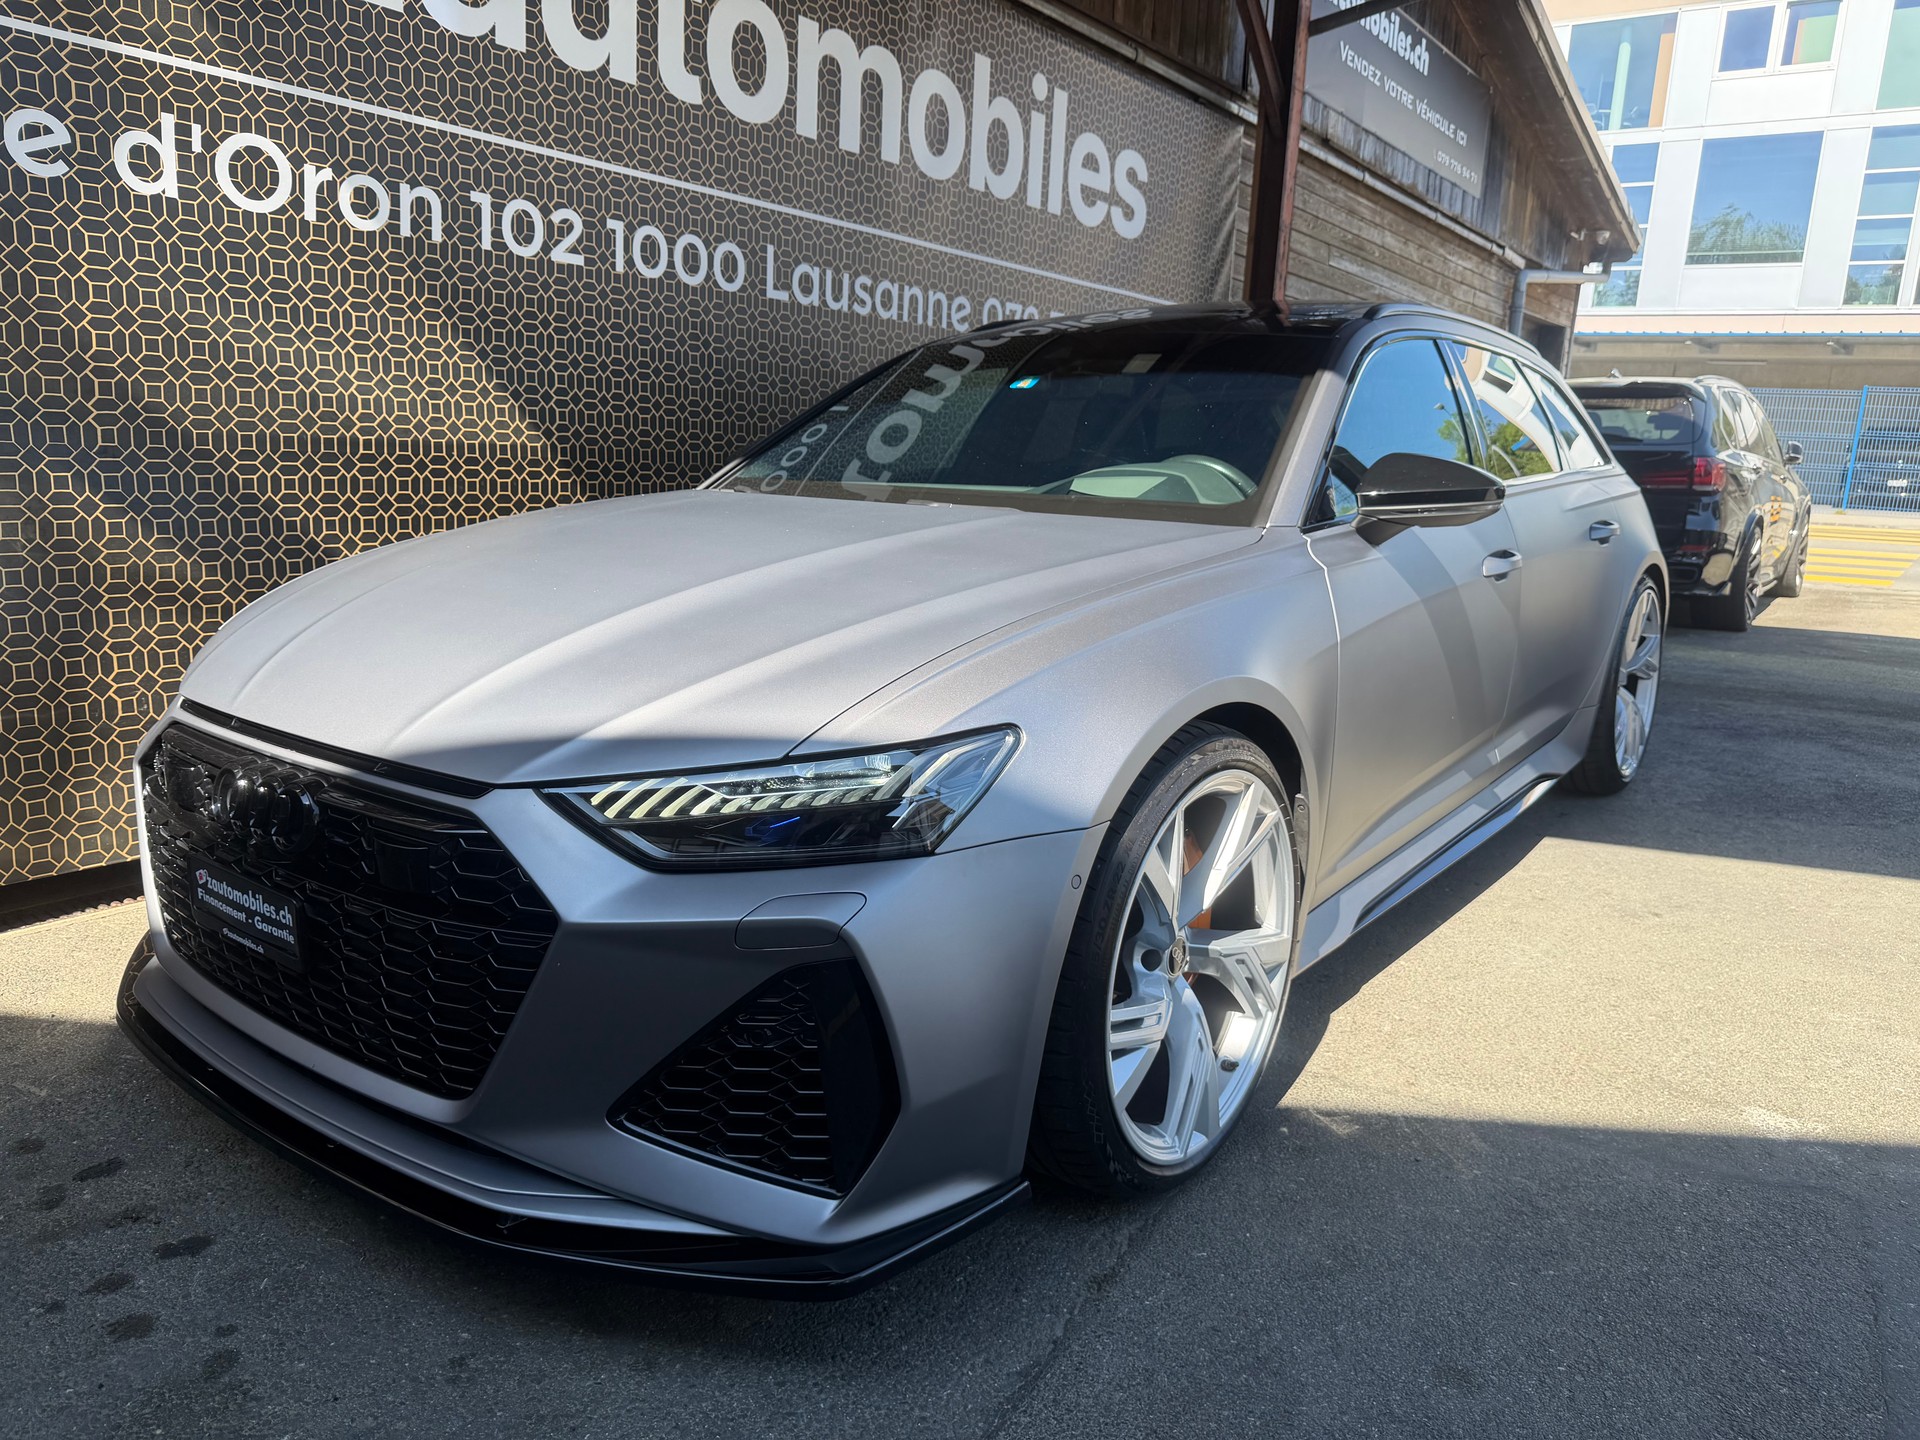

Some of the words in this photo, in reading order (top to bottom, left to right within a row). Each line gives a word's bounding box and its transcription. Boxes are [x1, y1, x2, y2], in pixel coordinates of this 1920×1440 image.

[362, 0, 1149, 240] utomobiles
[1339, 40, 1381, 87] VENDEZ
[1384, 75, 1414, 111] VOTRE
[1417, 98, 1456, 139] VÉHICULE
[1457, 128, 1468, 147] ICI
[113, 112, 443, 242] d'Oron
[469, 190, 585, 266] 102
[606, 218, 747, 293] 1000
[765, 244, 971, 333] Lausanne
[197, 887, 247, 924] Financement
[254, 915, 295, 945] Garantie
[206, 876, 293, 927] zautomobiles.ch
